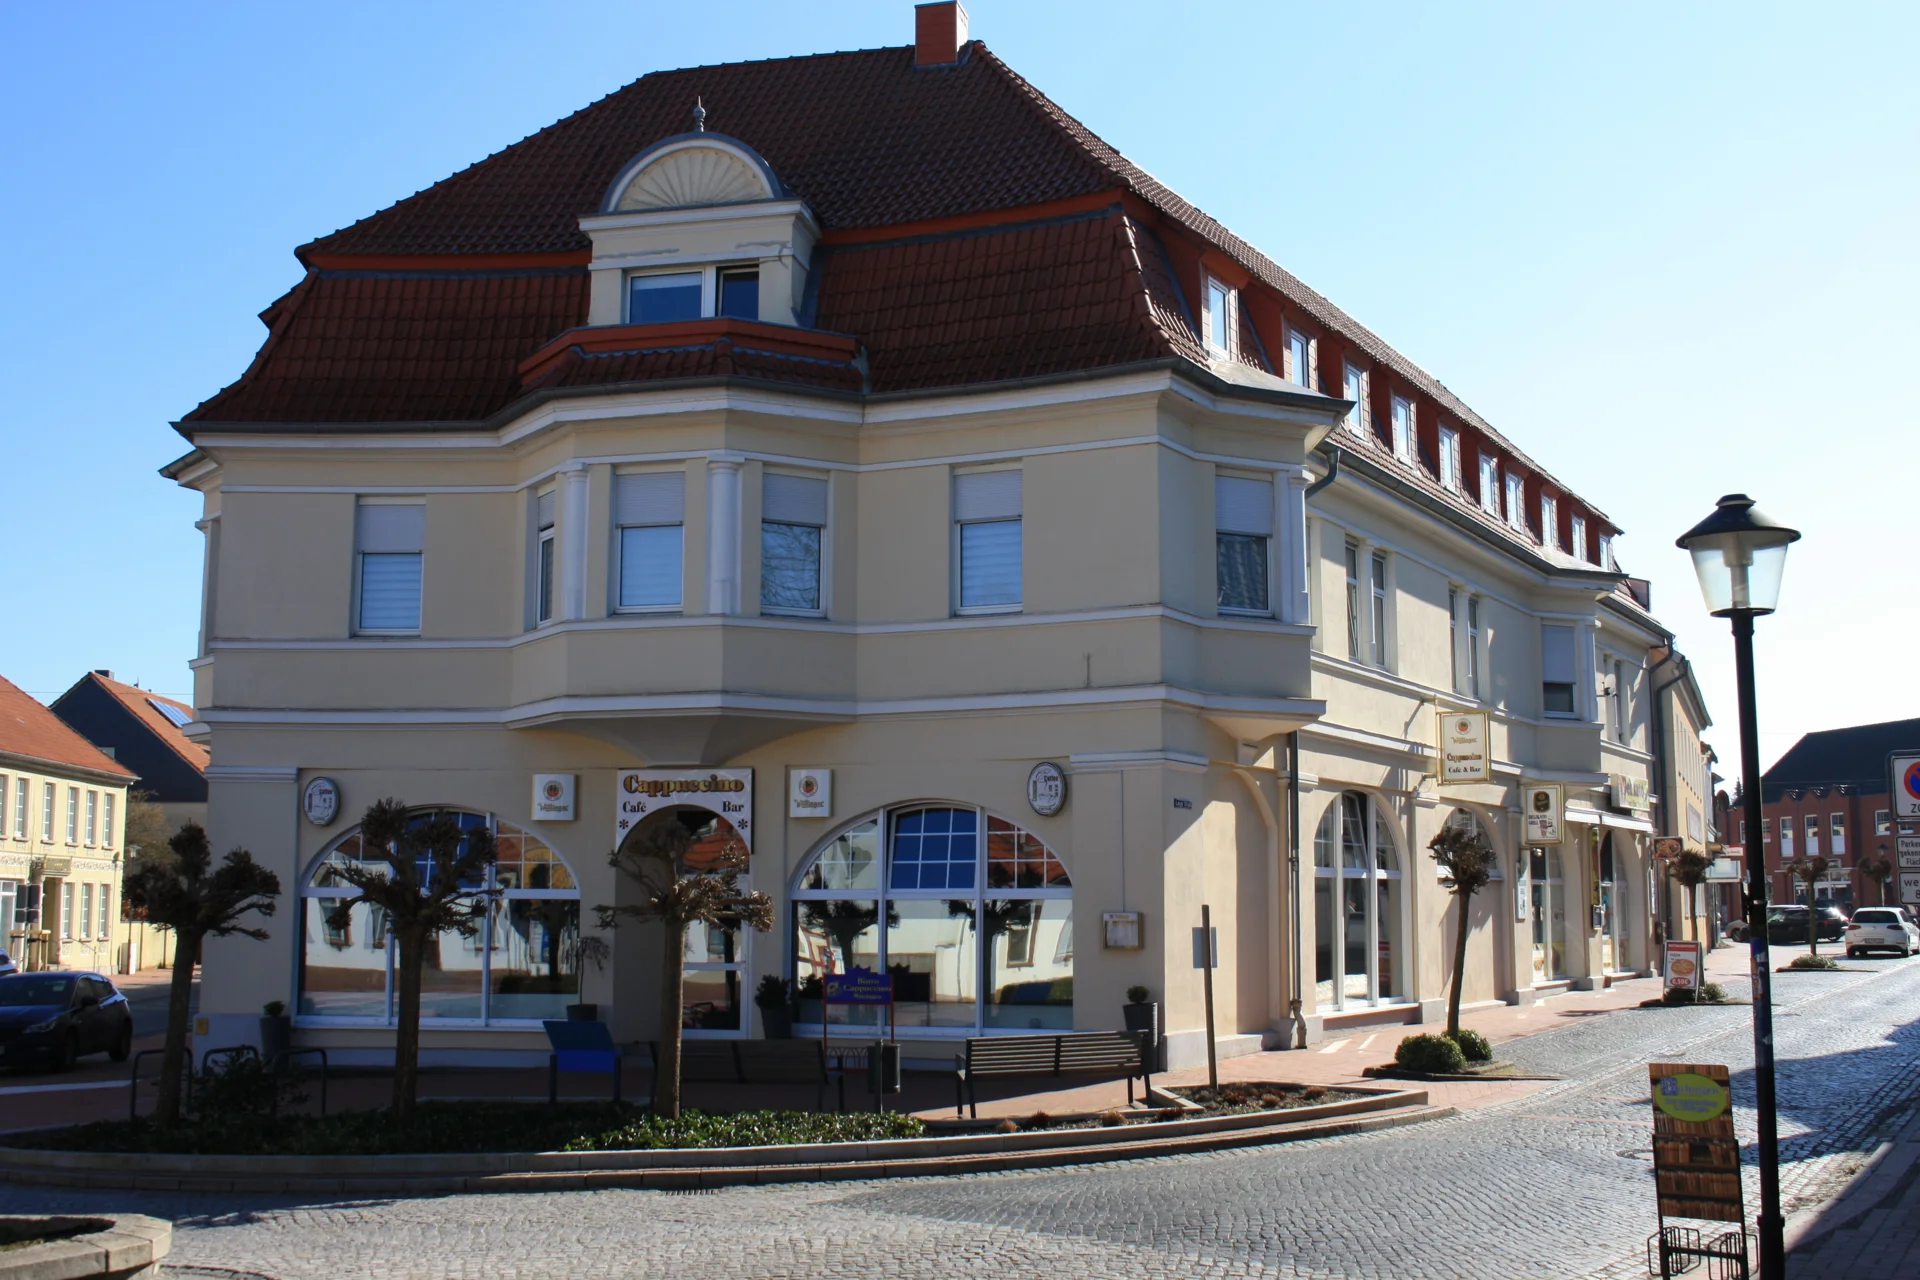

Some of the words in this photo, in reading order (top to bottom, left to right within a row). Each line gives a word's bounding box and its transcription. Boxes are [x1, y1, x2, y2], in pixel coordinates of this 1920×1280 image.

[623, 774, 745, 797] Cappuccino
[622, 801, 646, 813] Café
[722, 801, 744, 813] Bar
